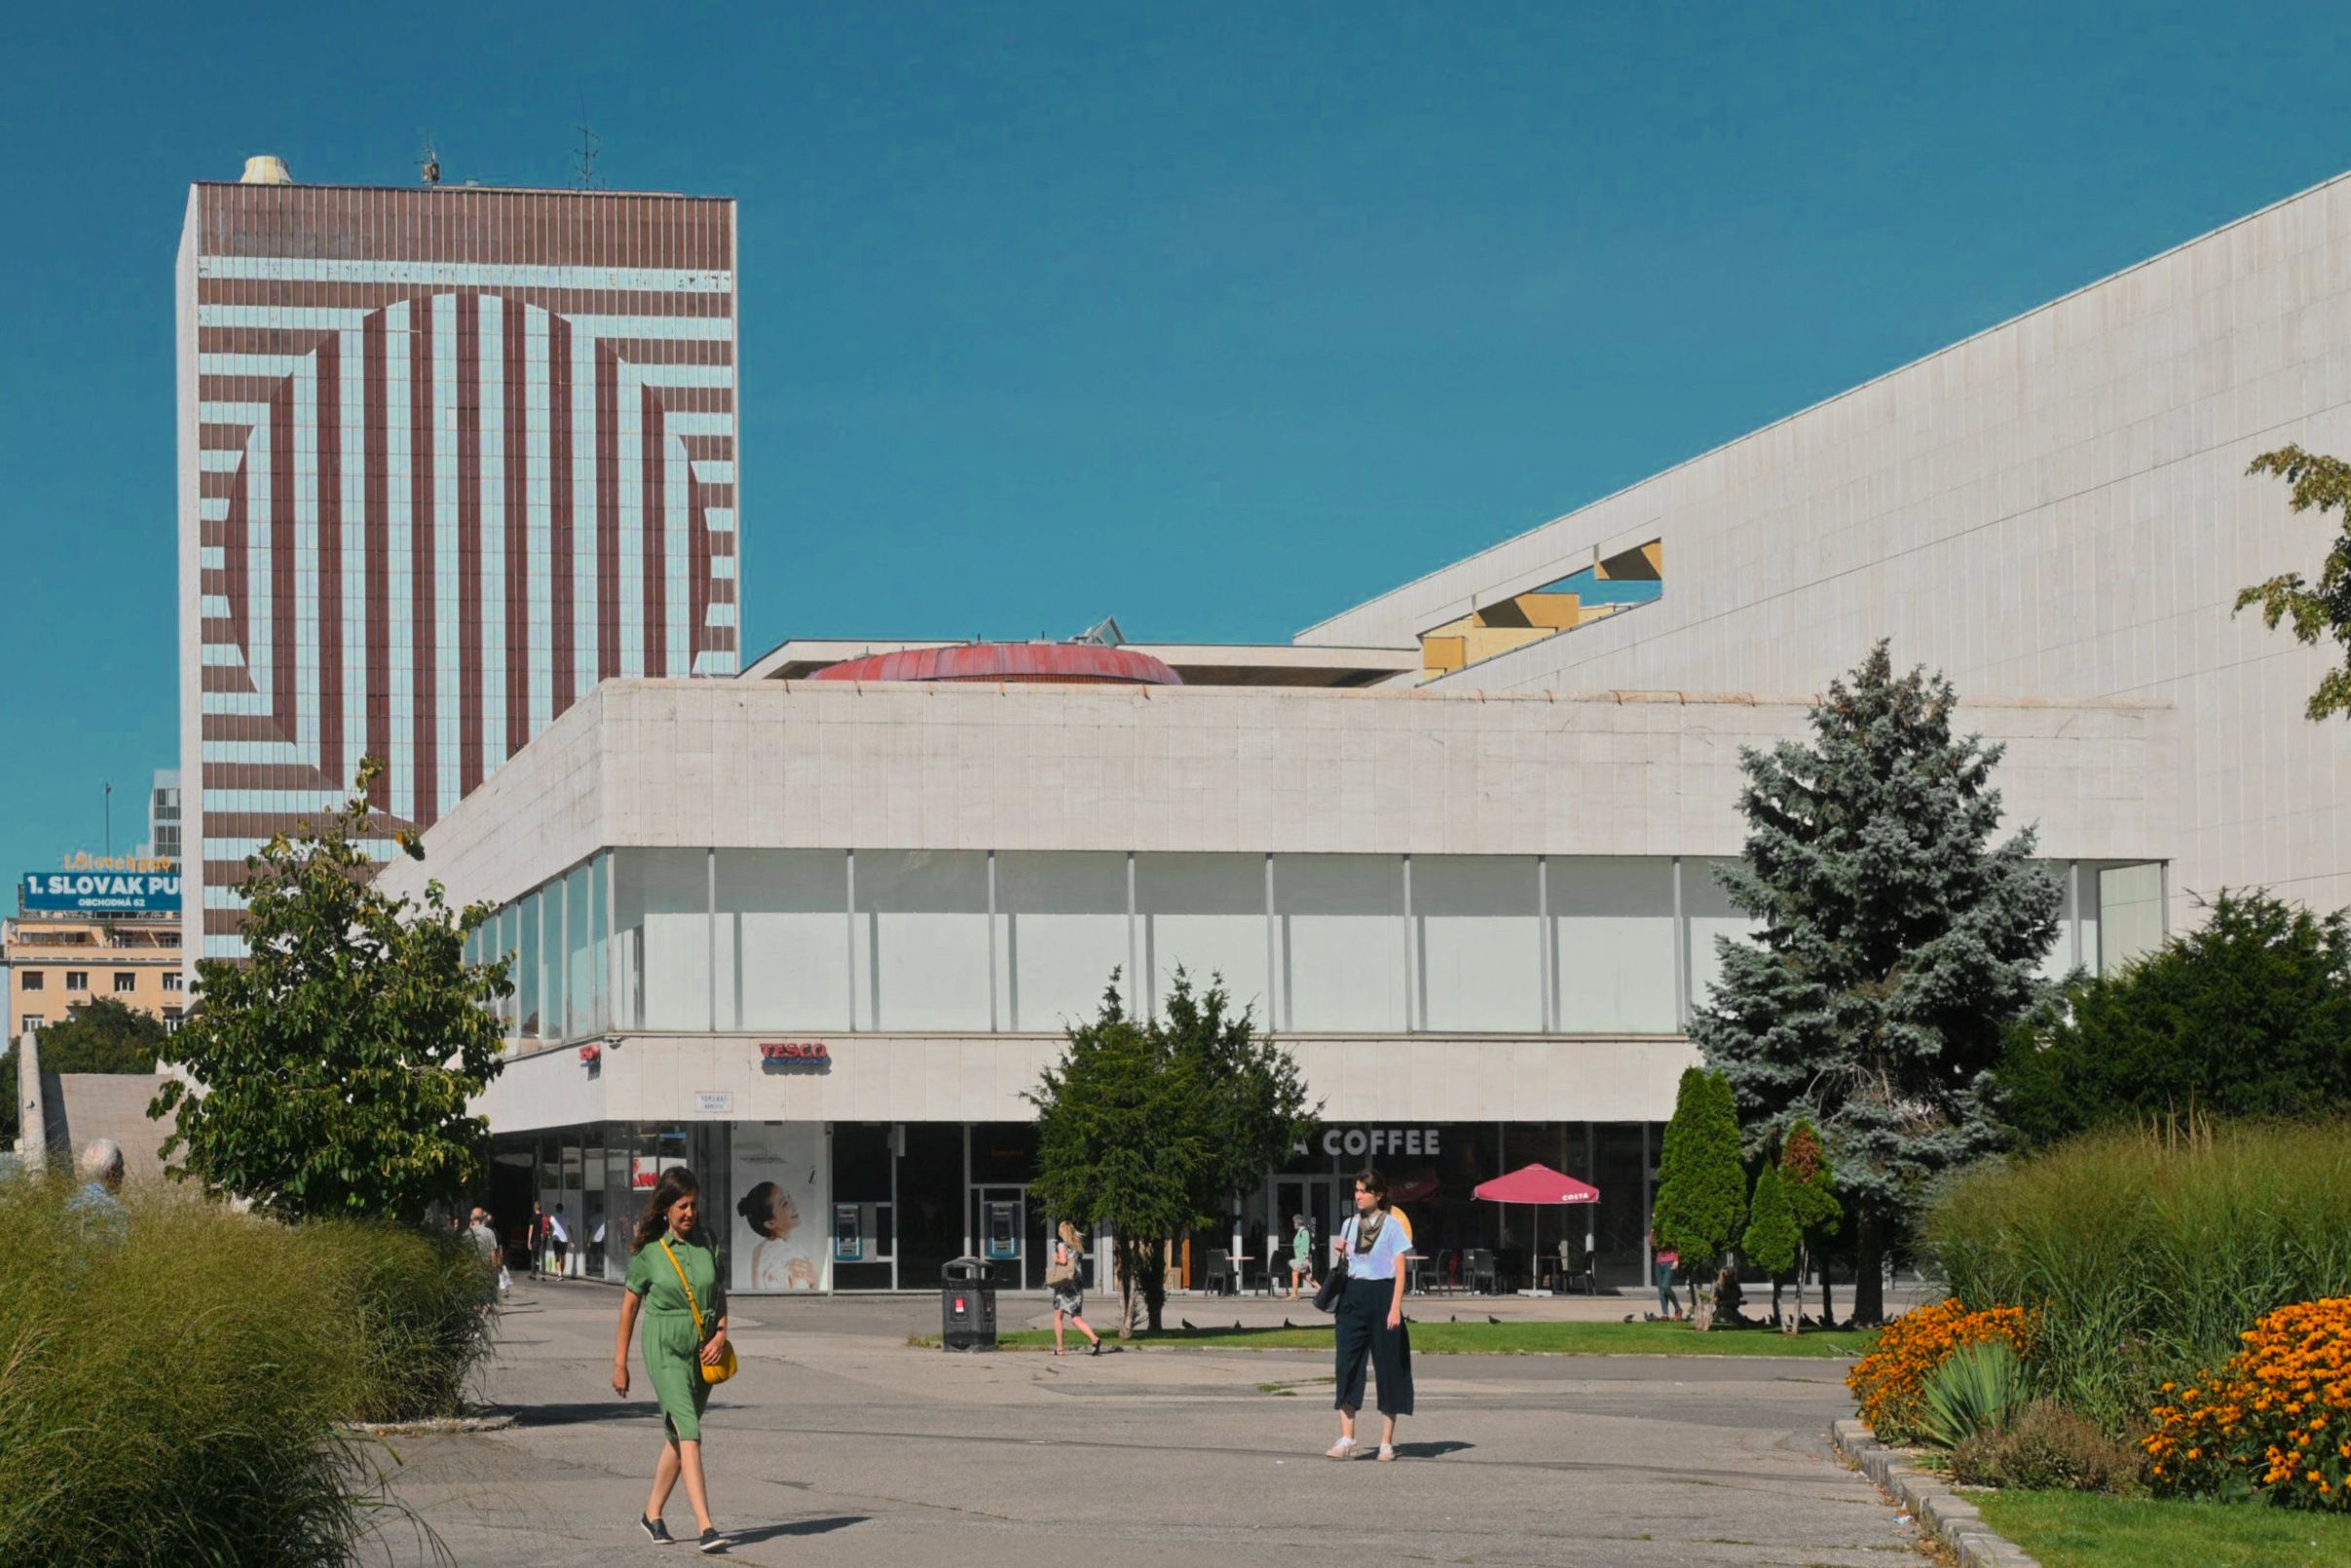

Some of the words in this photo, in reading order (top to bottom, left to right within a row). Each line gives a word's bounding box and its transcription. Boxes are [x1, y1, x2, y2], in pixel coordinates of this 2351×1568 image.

[27, 877, 43, 894] 1.
[49, 877, 144, 894] SLOVAK
[149, 877, 182, 895] PU
[78, 896, 131, 907] OBCHODNÁ
[133, 898, 145, 907] 62
[760, 1043, 827, 1059] TESCO
[1323, 1129, 1440, 1156] COFFEE
